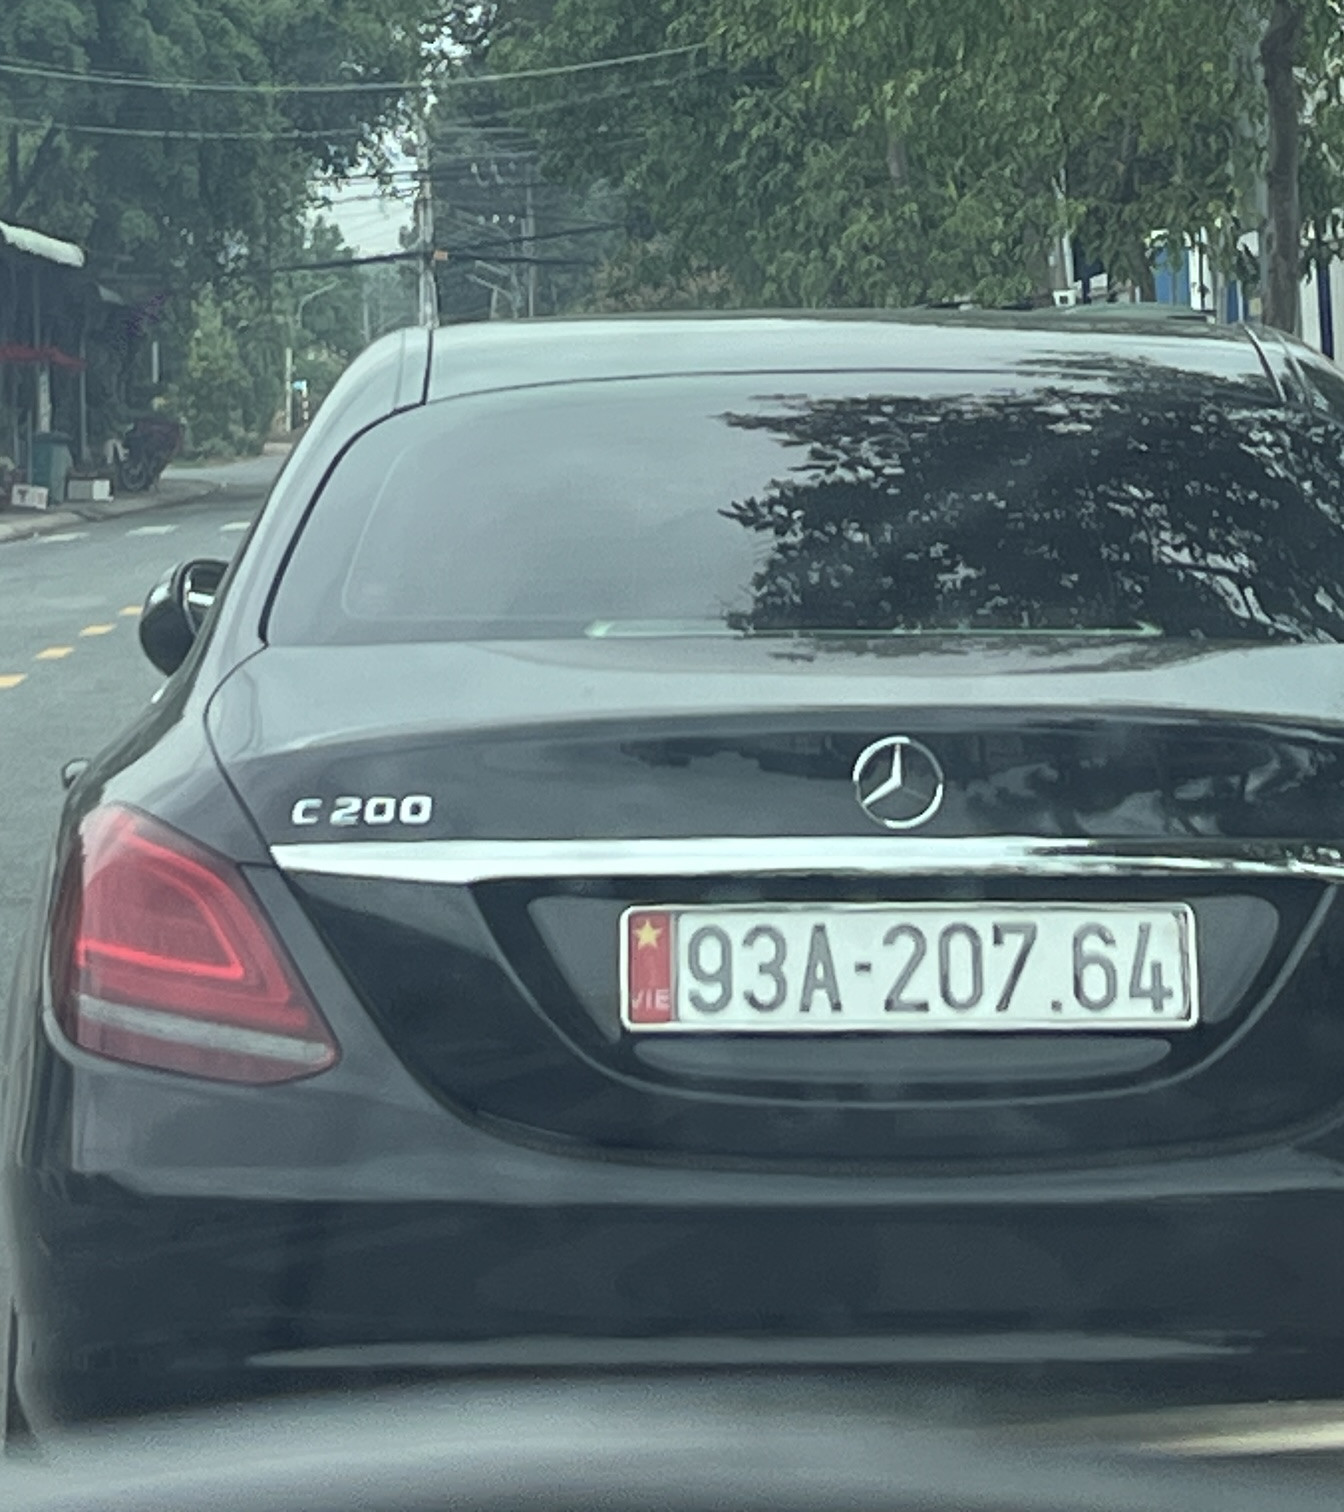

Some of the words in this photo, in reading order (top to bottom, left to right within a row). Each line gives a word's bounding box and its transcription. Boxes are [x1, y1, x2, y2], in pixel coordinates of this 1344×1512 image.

[291, 797, 323, 825] C
[329, 794, 433, 826] 200
[687, 922, 1174, 1014] 93A-207.64
